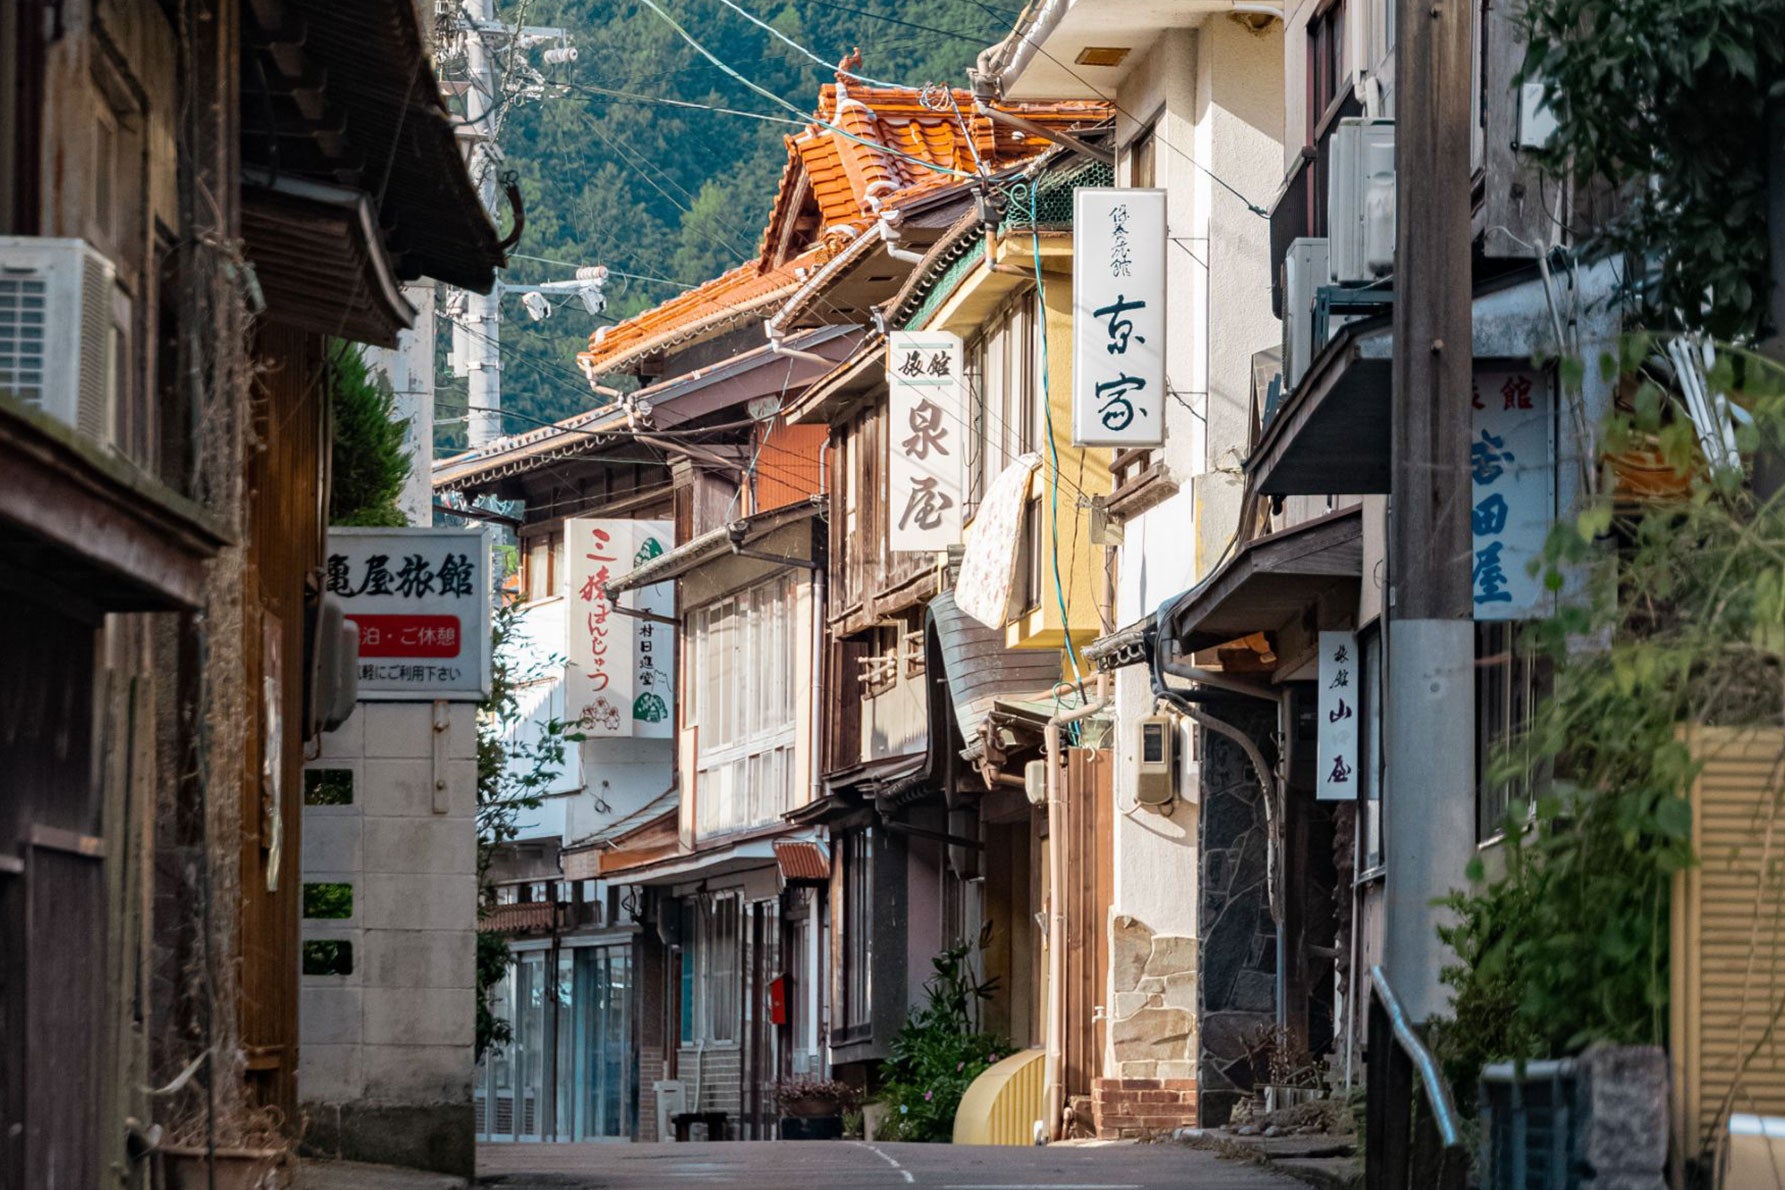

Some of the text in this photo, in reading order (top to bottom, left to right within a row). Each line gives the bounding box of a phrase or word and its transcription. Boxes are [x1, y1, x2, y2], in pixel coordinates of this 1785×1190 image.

[898, 350, 953, 379] 旅館
[1093, 294, 1148, 432] 京家
[898, 398, 954, 532] 泉屋
[357, 626, 457, 647] 泊・ご休憩
